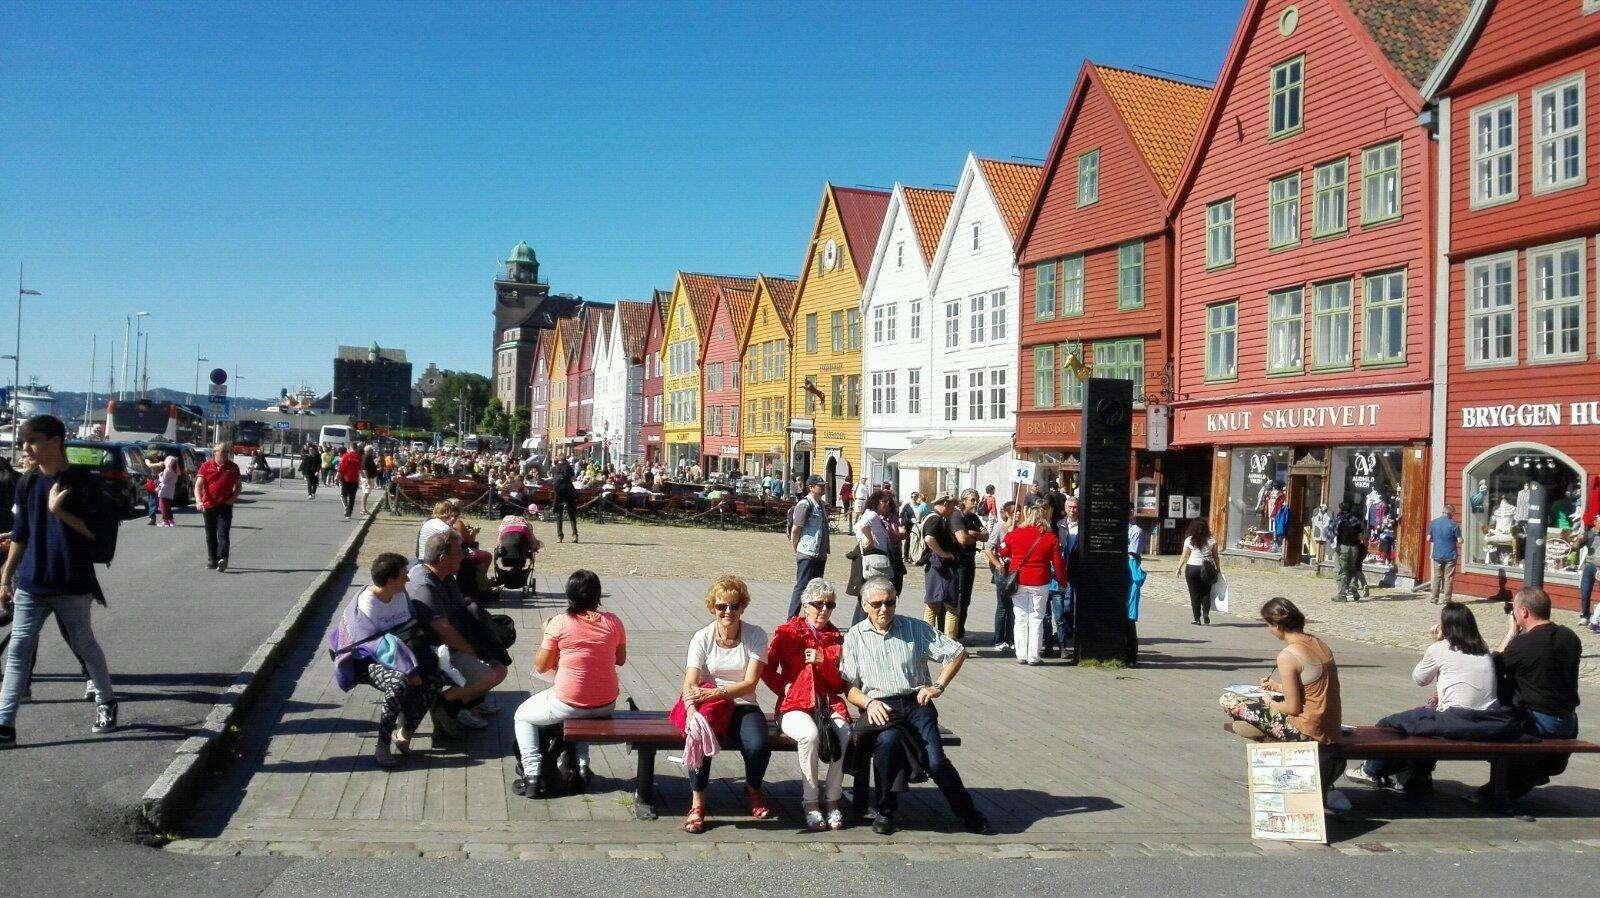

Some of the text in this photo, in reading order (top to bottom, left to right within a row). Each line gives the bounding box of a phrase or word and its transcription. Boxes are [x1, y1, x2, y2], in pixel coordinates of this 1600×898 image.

[1206, 404, 1380, 432] KNUT SKURTVEIT
[1461, 403, 1561, 428] BRYGGEN
[1016, 469, 1029, 479] 14
